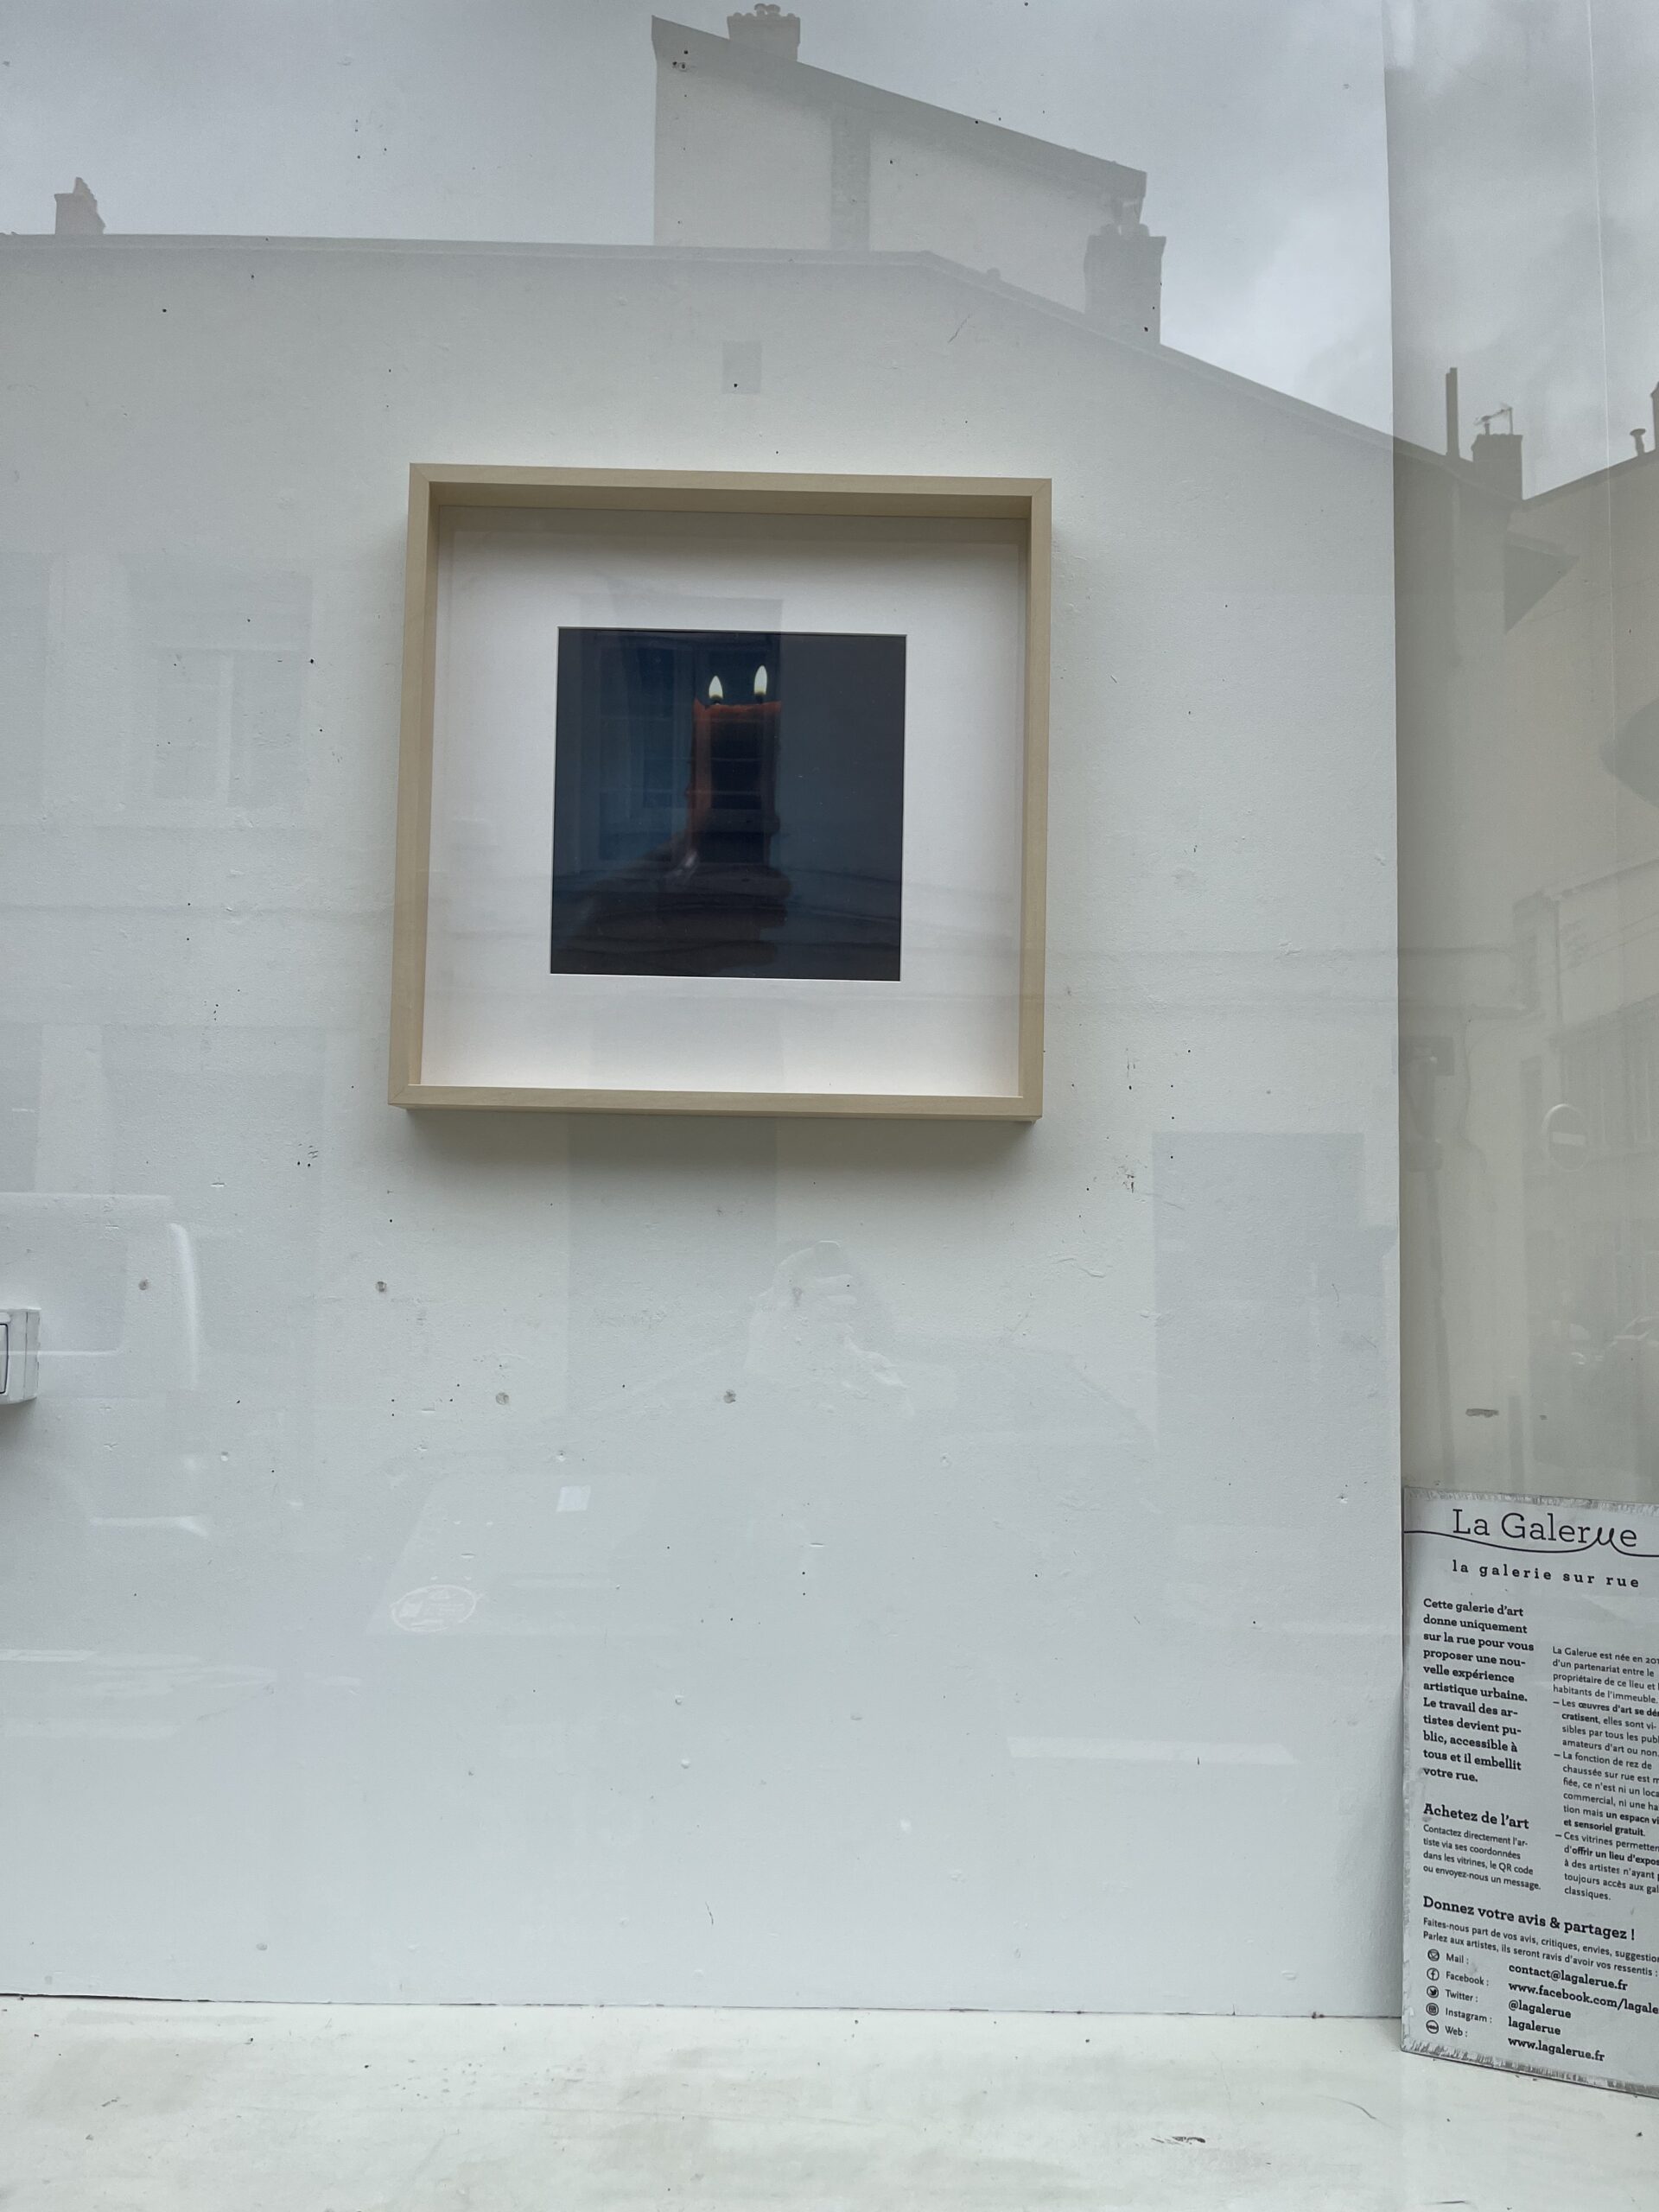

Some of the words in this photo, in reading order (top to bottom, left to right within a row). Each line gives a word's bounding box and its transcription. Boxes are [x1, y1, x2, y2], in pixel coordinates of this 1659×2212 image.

[1452, 1509, 1490, 1535] La
[1501, 1512, 1637, 1548] Galerue
[1452, 1559, 1469, 1573] la
[1479, 1564, 1551, 1580] galerie
[1563, 1573, 1595, 1584] sur
[1606, 1577, 1638, 1587] rue
[1423, 1599, 1453, 1610] Cette
[1456, 1601, 1494, 1614] galerie
[1497, 1605, 1523, 1617] d’art
[1423, 1613, 1457, 1626] donne
[1459, 1619, 1528, 1634] uniquement
[1423, 1633, 1441, 1642] sur
[1444, 1631, 1454, 1643] la
[1456, 1637, 1475, 1645] rue
[1478, 1639, 1505, 1649] pour
[1507, 1642, 1534, 1651] vous
[1423, 1649, 1473, 1662] proposer
[1476, 1656, 1497, 1664] une
[1499, 1658, 1526, 1667] nou-
[1553, 1646, 1562, 1655] La
[1565, 1647, 1598, 1658] Galerue
[1423, 1664, 1450, 1675] velle
[1452, 1669, 1515, 1683] expérience
[1553, 1658, 1571, 1669] d'un
[1574, 1663, 1619, 1674] partenariat
[1647, 1668, 1654, 1677] le
[1553, 1674, 1602, 1684] propriétaire
[1605, 1677, 1614, 1686] de
[1629, 1679, 1644, 1689] lieu
[1423, 1682, 1478, 1697] artistique
[1480, 1687, 1528, 1702] urbaine.
[1554, 1684, 1592, 1696] habitants
[1595, 1689, 1605, 1698] de
[1423, 1697, 1436, 1707] Le
[1439, 1700, 1476, 1713] travail
[1478, 1703, 1497, 1715] des
[1562, 1699, 1575, 1707] Les
[1578, 1702, 1610, 1711] œuvres
[1612, 1704, 1632, 1714] d'art
[1423, 1714, 1454, 1727] tistes
[1457, 1717, 1499, 1732] devient
[1502, 1726, 1522, 1736] pu-
[1604, 1716, 1622, 1726] elles
[1423, 1730, 1447, 1745] blic,
[1450, 1737, 1508, 1751] accessible
[1511, 1742, 1517, 1752] à
[1562, 1725, 1586, 1735] sibles
[1605, 1731, 1624, 1739] tous
[1627, 1732, 1638, 1741] les
[1562, 1739, 1602, 1750] amateurs
[1605, 1743, 1624, 1753] d'art
[1423, 1749, 1447, 1760] tous
[1450, 1753, 1461, 1763] et
[1464, 1752, 1471, 1764] il
[1474, 1756, 1522, 1770] embellit
[1563, 1751, 1573, 1760] La
[1575, 1751, 1610, 1764] fonction
[1612, 1757, 1624, 1766] de
[1642, 1760, 1652, 1770] de
[1423, 1767, 1453, 1778] votre
[1455, 1772, 1478, 1783] rue.
[1562, 1764, 1602, 1777] chaussée
[1595, 1782, 1616, 1792] n'est
[1423, 1803, 1478, 1821] Achetez
[1481, 1810, 1497, 1824] de
[1501, 1813, 1529, 1829] l’art
[1563, 1804, 1580, 1814] tion
[1583, 1808, 1603, 1817] mais
[1423, 1824, 1461, 1837] Contactez
[1464, 1829, 1510, 1845] directement
[1513, 1836, 1528, 1847] l'ar-
[1574, 1821, 1612, 1832] sensoriel
[1564, 1832, 1579, 1841] Ces
[1581, 1834, 1613, 1846] vitrines
[1423, 1838, 1440, 1847] tiste
[1441, 1840, 1452, 1849] via
[1470, 1847, 1521, 1859] coordonnées
[1564, 1845, 1593, 1856] d'offrir
[1609, 1851, 1624, 1860] lieu
[1423, 1850, 1442, 1860] dans
[1444, 1853, 1454, 1863] les
[1490, 1860, 1497, 1869] le
[1498, 1862, 1512, 1872] QR
[1514, 1866, 1533, 1875] code
[1572, 1859, 1586, 1869] des
[1589, 1864, 1620, 1874] artistes
[1624, 1867, 1655, 1879] n'ayant
[1435, 1867, 1489, 1882] envoyez-nous
[1564, 1873, 1600, 1885] toujours
[1603, 1880, 1626, 1889] accès
[1423, 1895, 1474, 1916] Donnez
[1478, 1908, 1514, 1922] votre
[1518, 1914, 1546, 1927] avis
[1564, 1922, 1627, 1940] partagez
[1423, 1917, 1469, 1933] Faites-nous
[1491, 1929, 1501, 1938] de
[1503, 1932, 1517, 1941] vos
[1423, 1930, 1447, 1942] Parlez
[1450, 1937, 1464, 1946] aux
[1502, 1944, 1510, 1953] ils
[1514, 1948, 1540, 1958] seront
[1542, 1953, 1561, 1961] ravis
[1565, 1954, 1594, 1967] d'avoir
[1614, 1964, 1652, 1976] ressentis
[1446, 1953, 1464, 1963] Mail
[1446, 1971, 1484, 1986] Facebook
[1509, 1965, 1628, 1991] contact@lagalerue.fr
[1445, 1989, 1473, 2001] Twitter
[1446, 2007, 1487, 2023] Instagram
[1509, 1999, 1571, 2018] @lagalerue
[1445, 2025, 1463, 2036] Web
[1508, 2016, 1560, 2035] lagalerue
[1508, 2037, 1605, 2062] www.lagalerue.fr
